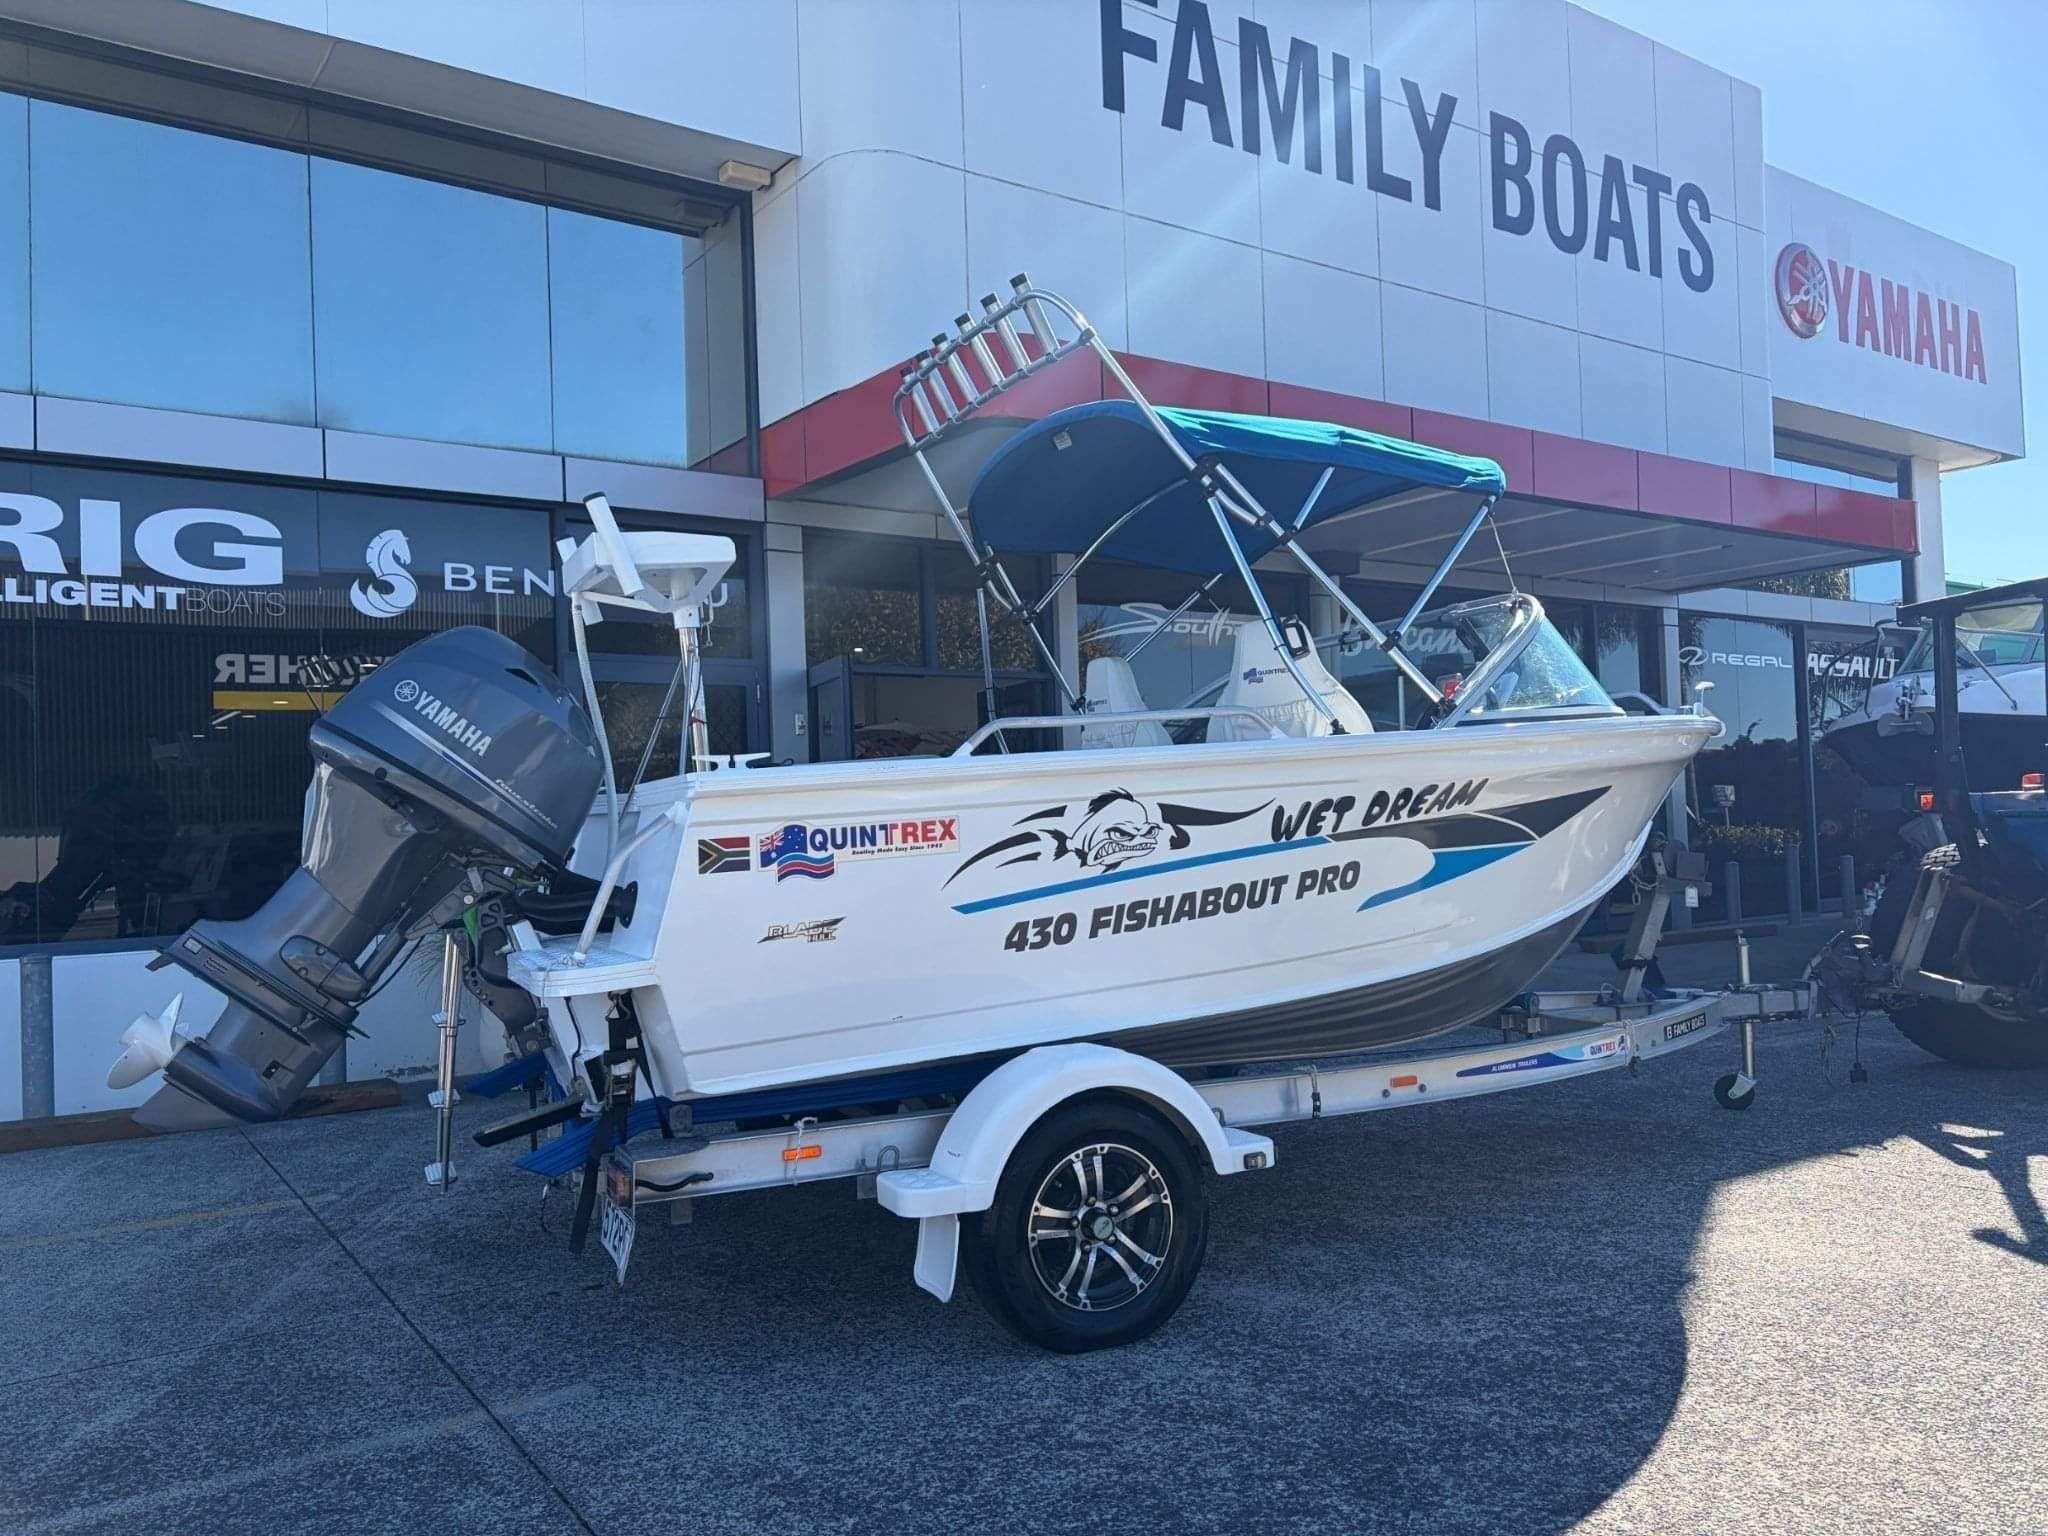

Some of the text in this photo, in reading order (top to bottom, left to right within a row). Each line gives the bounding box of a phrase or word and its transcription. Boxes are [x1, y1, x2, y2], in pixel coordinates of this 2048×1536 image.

[1100, 0, 1714, 293] FAMILY BOATS
[1827, 258, 1987, 385] YAMAHA
[185, 587, 287, 616] BOATS
[1711, 652, 1793, 668] REGAL
[413, 690, 493, 758] YAMAHA
[809, 818, 957, 852] QUINTREX
[1271, 777, 1490, 843] WET DREAM
[1003, 860, 1361, 953] 430 FISHABOUT PRO
